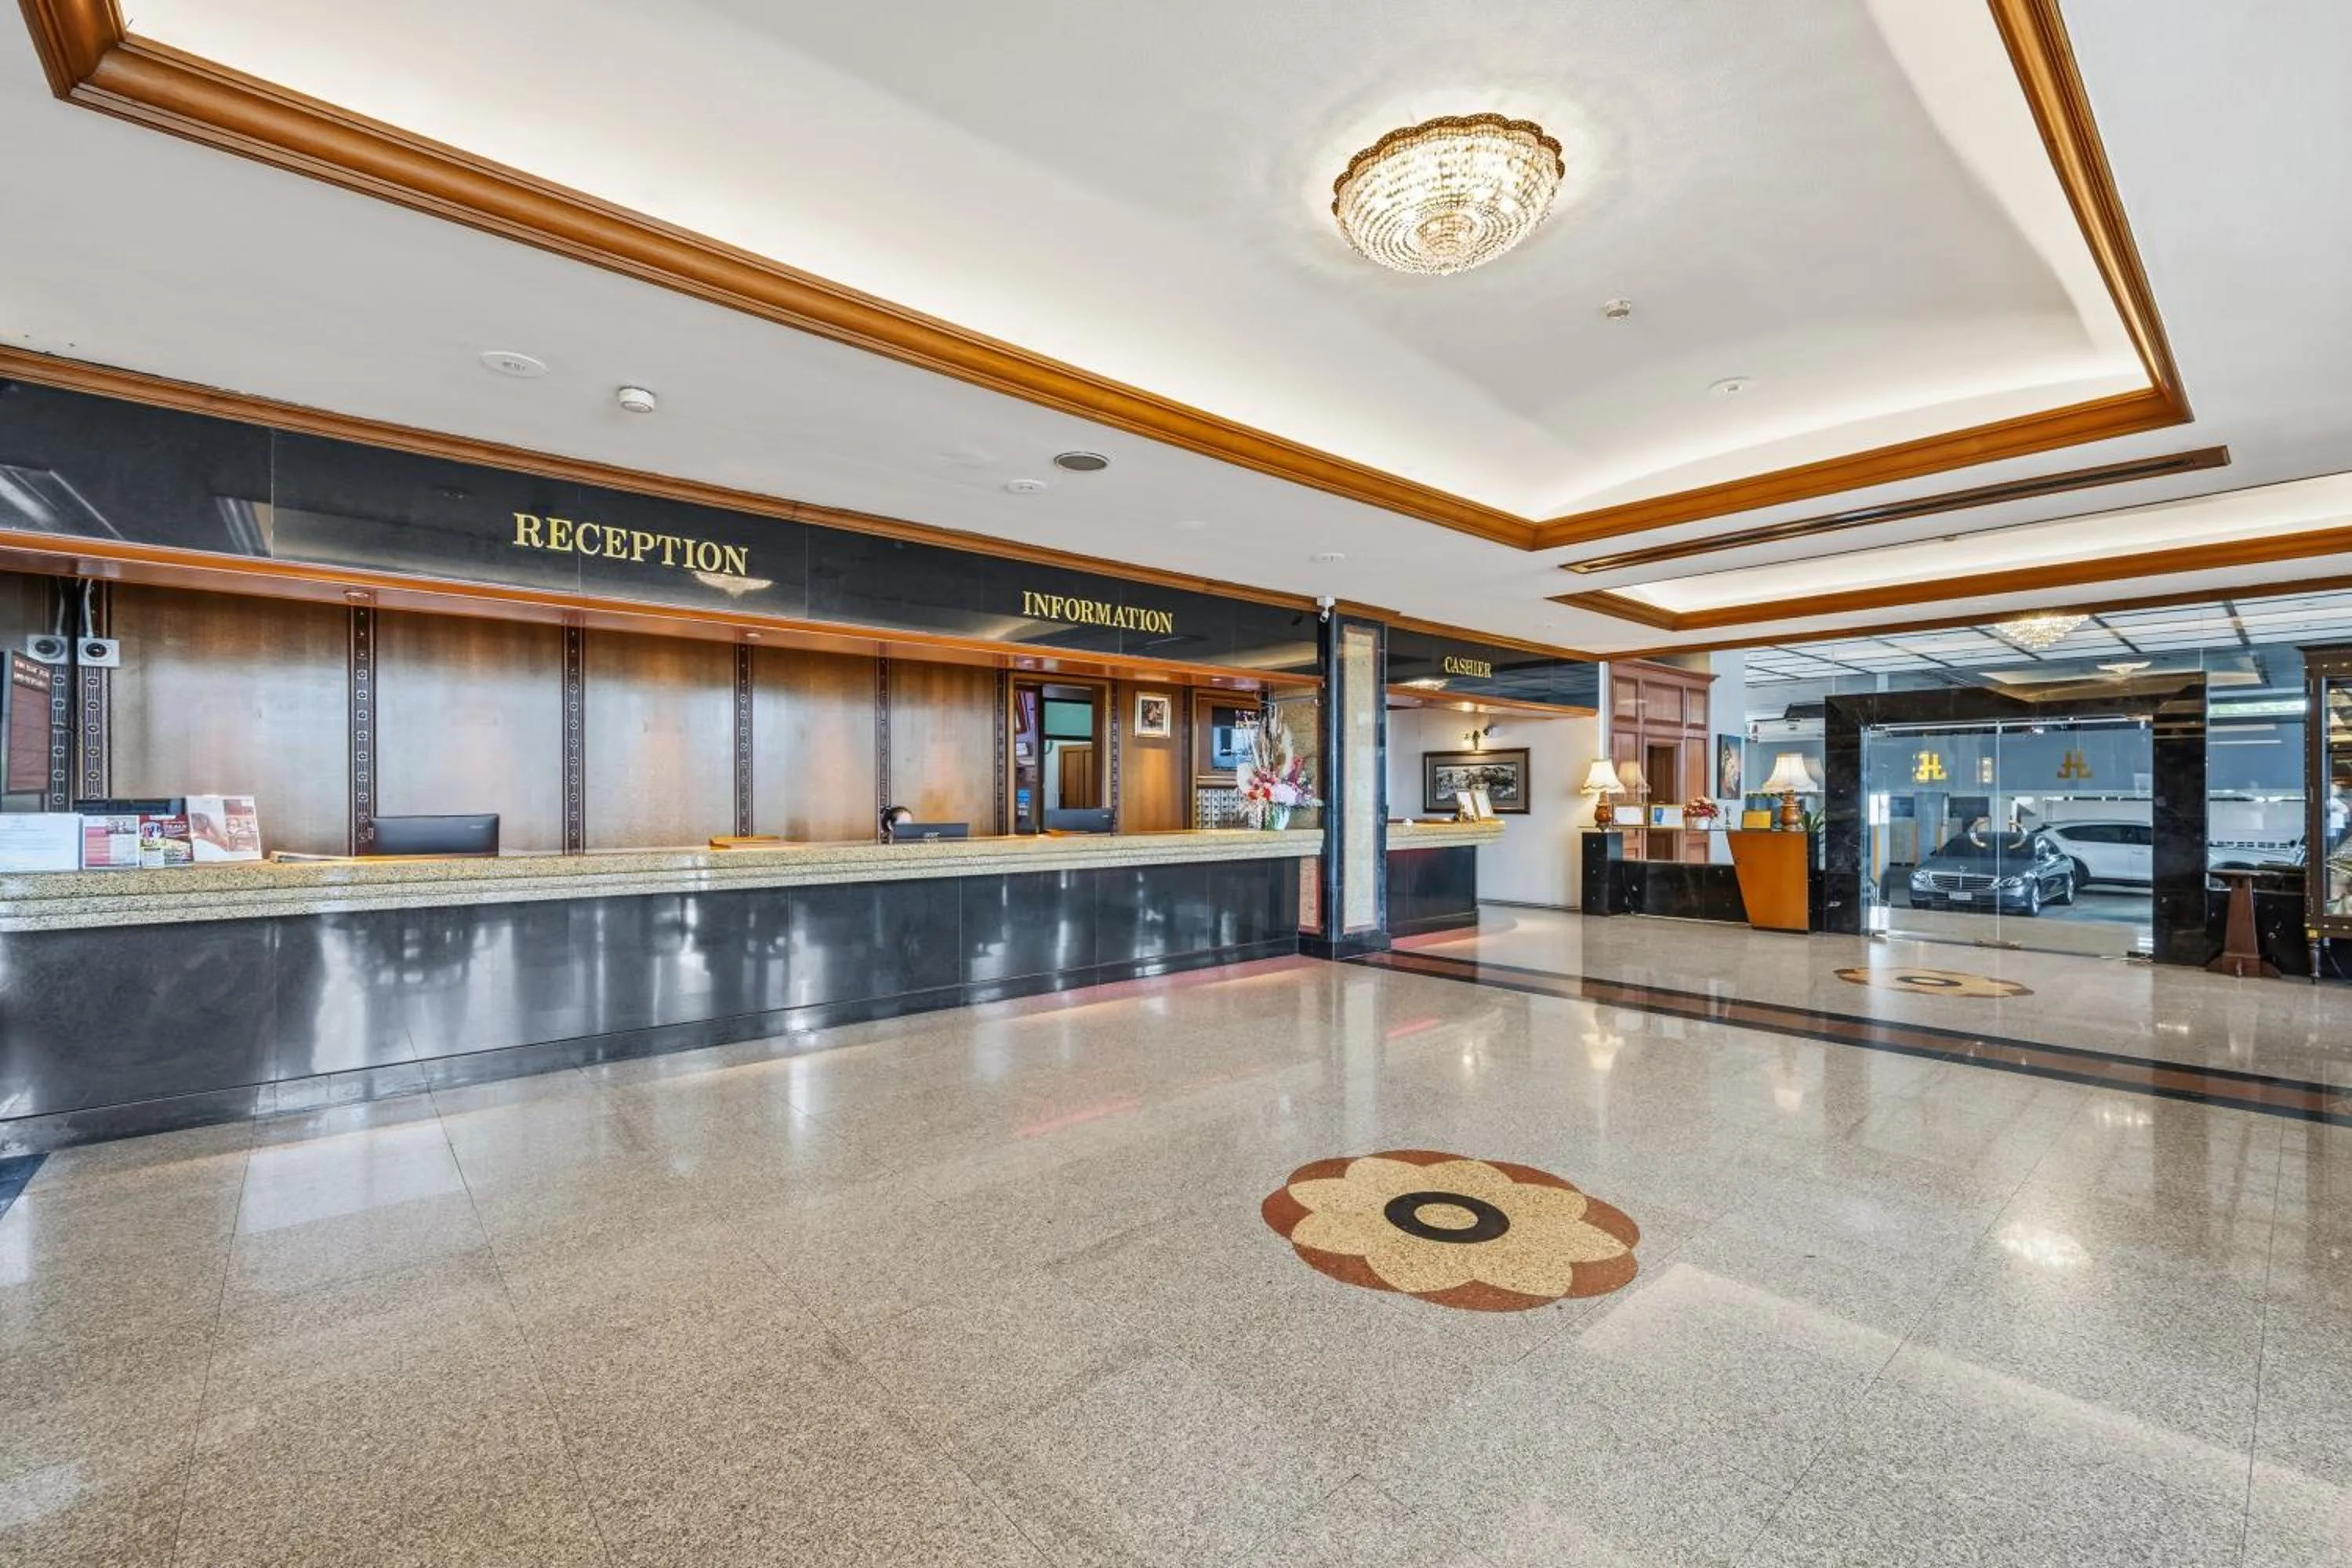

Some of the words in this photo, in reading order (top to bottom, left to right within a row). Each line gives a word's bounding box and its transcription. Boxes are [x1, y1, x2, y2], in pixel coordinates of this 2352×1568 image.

[513, 512, 749, 575] RECEPTION
[1022, 590, 1174, 634] INFORMATION
[1444, 655, 1493, 678] CASHIER
